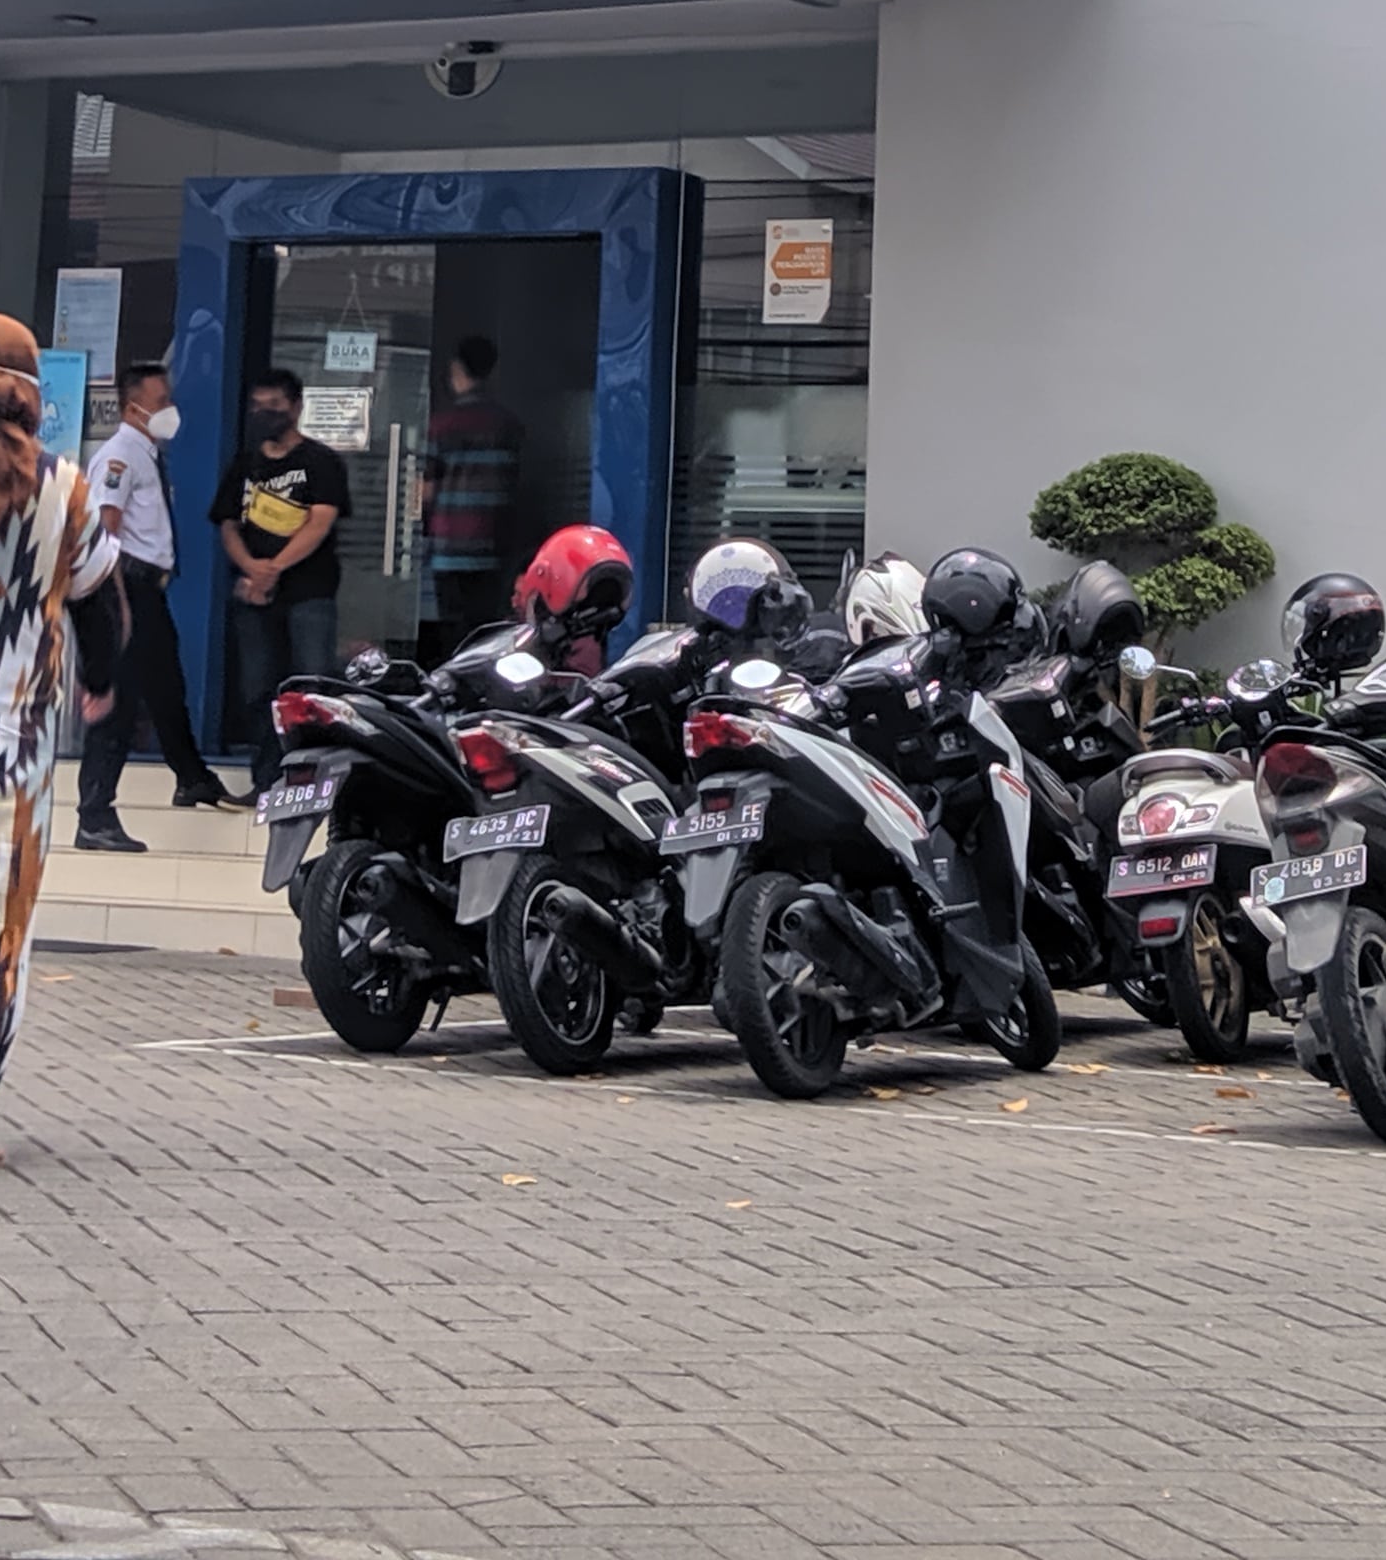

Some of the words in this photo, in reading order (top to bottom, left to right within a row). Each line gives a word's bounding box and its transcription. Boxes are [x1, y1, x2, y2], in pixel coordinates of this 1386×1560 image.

[331, 344, 370, 357] BUKA
[450, 822, 462, 839] S
[469, 815, 508, 836] 4635
[666, 820, 679, 836] K
[688, 810, 727, 833] 5155
[741, 802, 762, 822] FE
[1117, 860, 1129, 877] S
[1136, 856, 1173, 874] 6512
[1258, 868, 1269, 885] S
[1279, 856, 1324, 879] 4859
